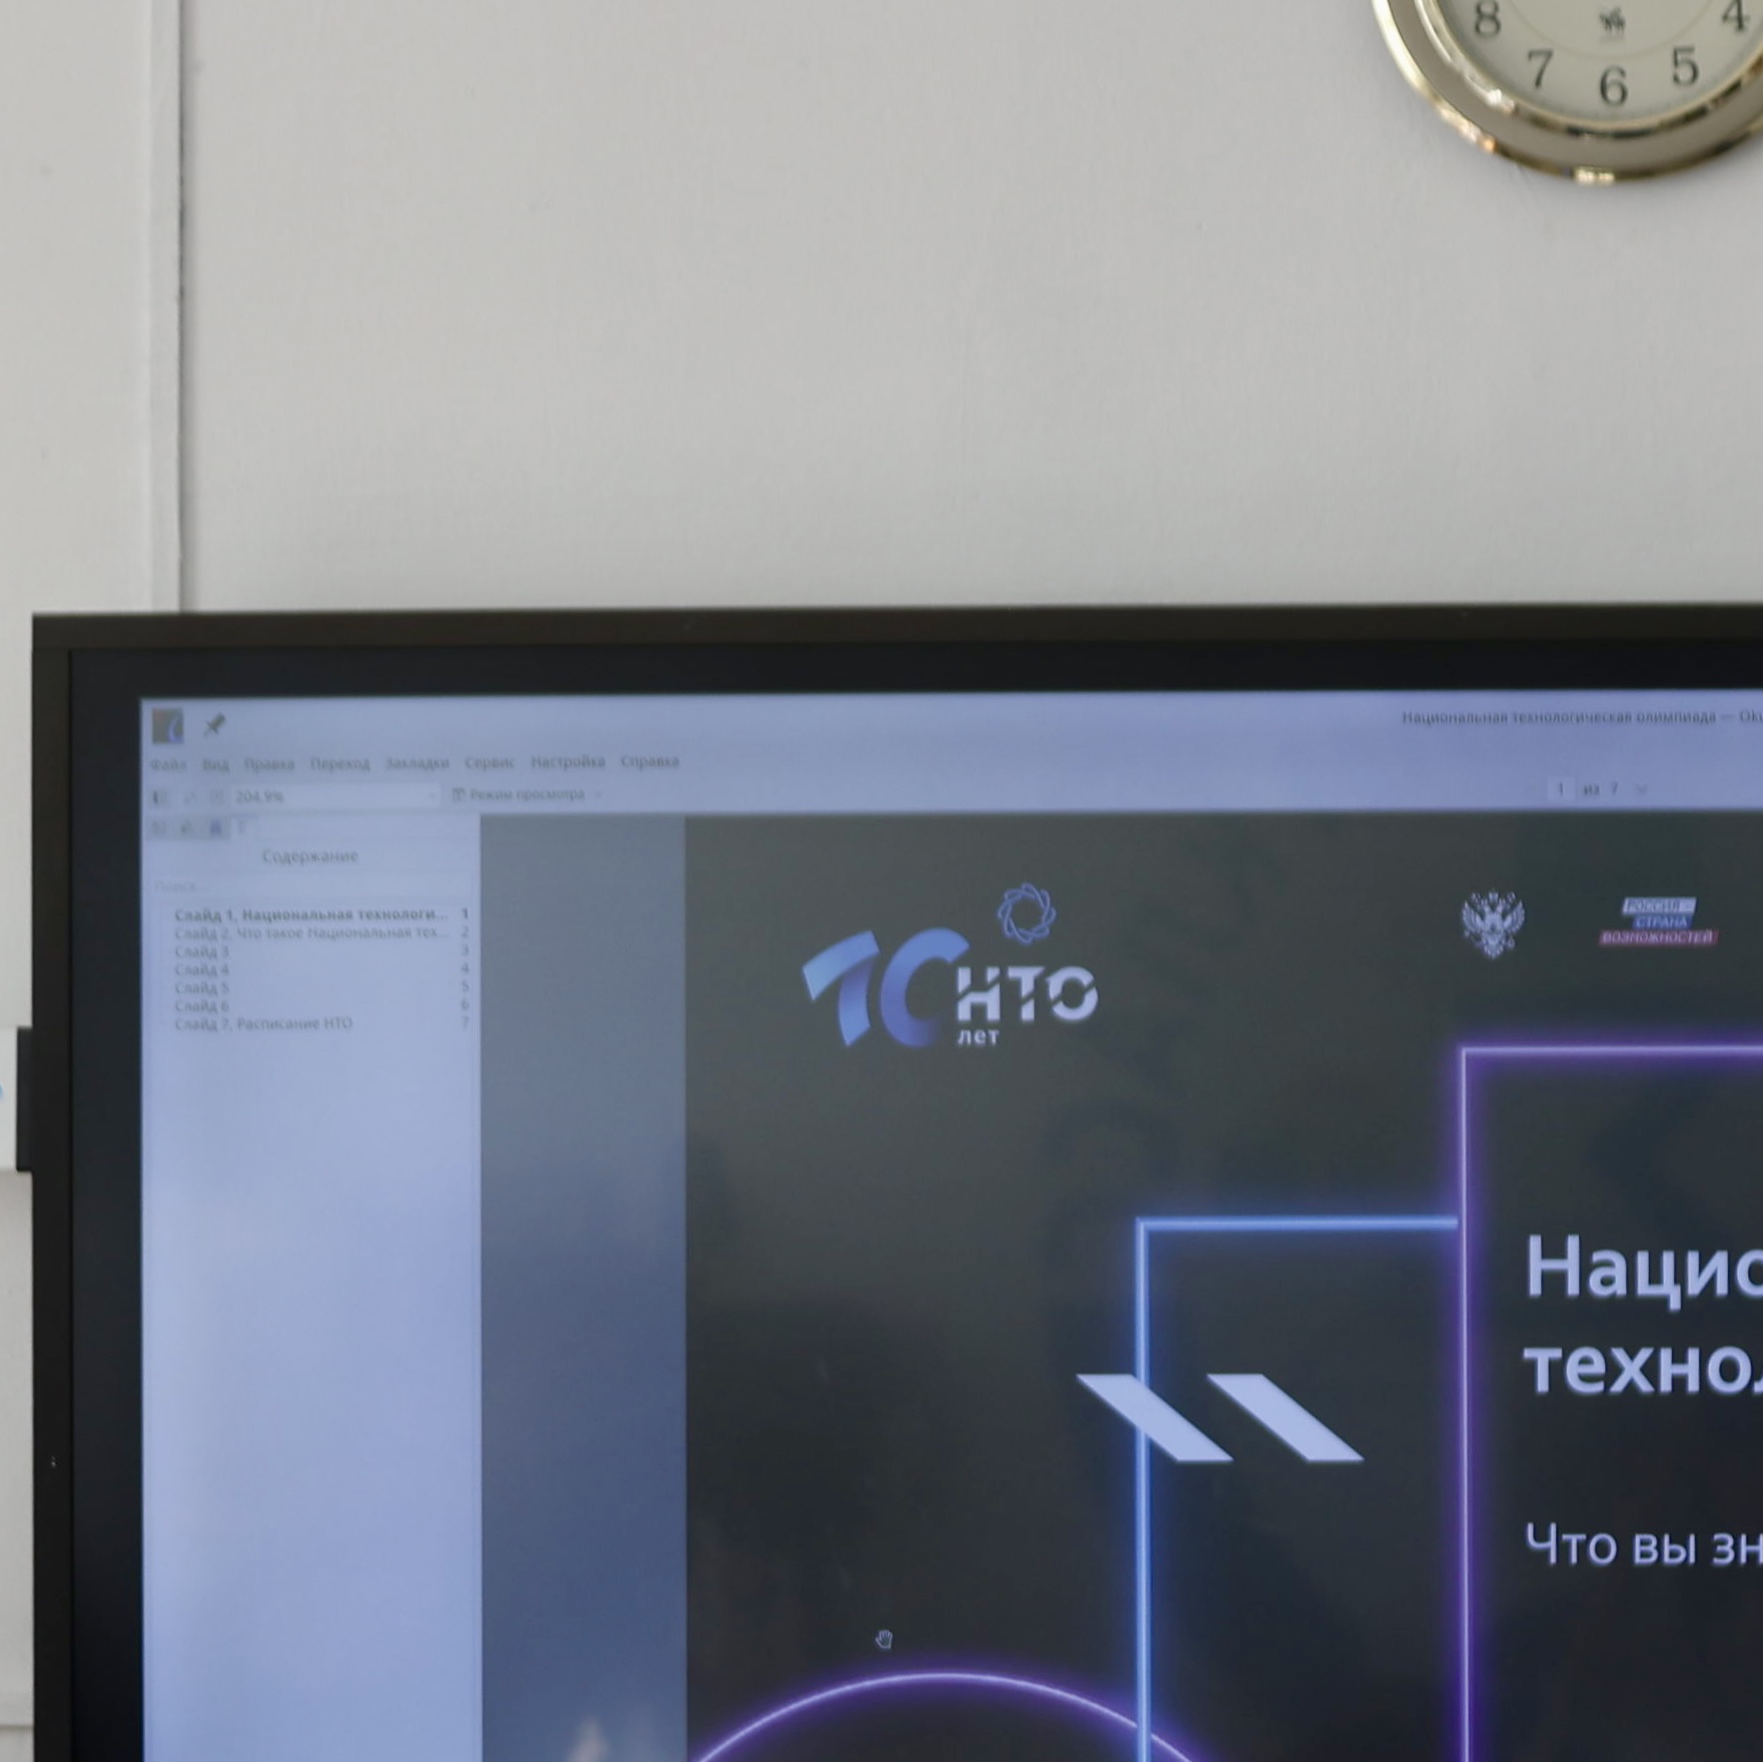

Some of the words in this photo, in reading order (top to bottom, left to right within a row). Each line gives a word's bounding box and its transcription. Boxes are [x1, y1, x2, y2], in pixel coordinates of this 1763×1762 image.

[1473, 0, 1501, 37] 8
[1721, 0, 1747, 34] 4
[1527, 49, 1554, 90] 7
[1671, 47, 1700, 87] 5
[1598, 68, 1629, 107] 6
[202, 756, 231, 775] Вид
[244, 756, 297, 775] Правка
[310, 756, 372, 774] Переход
[531, 753, 608, 773] Настройка
[619, 753, 681, 772] Справка
[261, 848, 359, 868] Содержание
[174, 907, 222, 925] Слайд
[241, 908, 354, 925] Национальная
[956, 965, 1099, 1022] НТО
[957, 1028, 1000, 1047] лет
[1525, 1521, 1618, 1567] Что
[1633, 1532, 1697, 1566] вы
